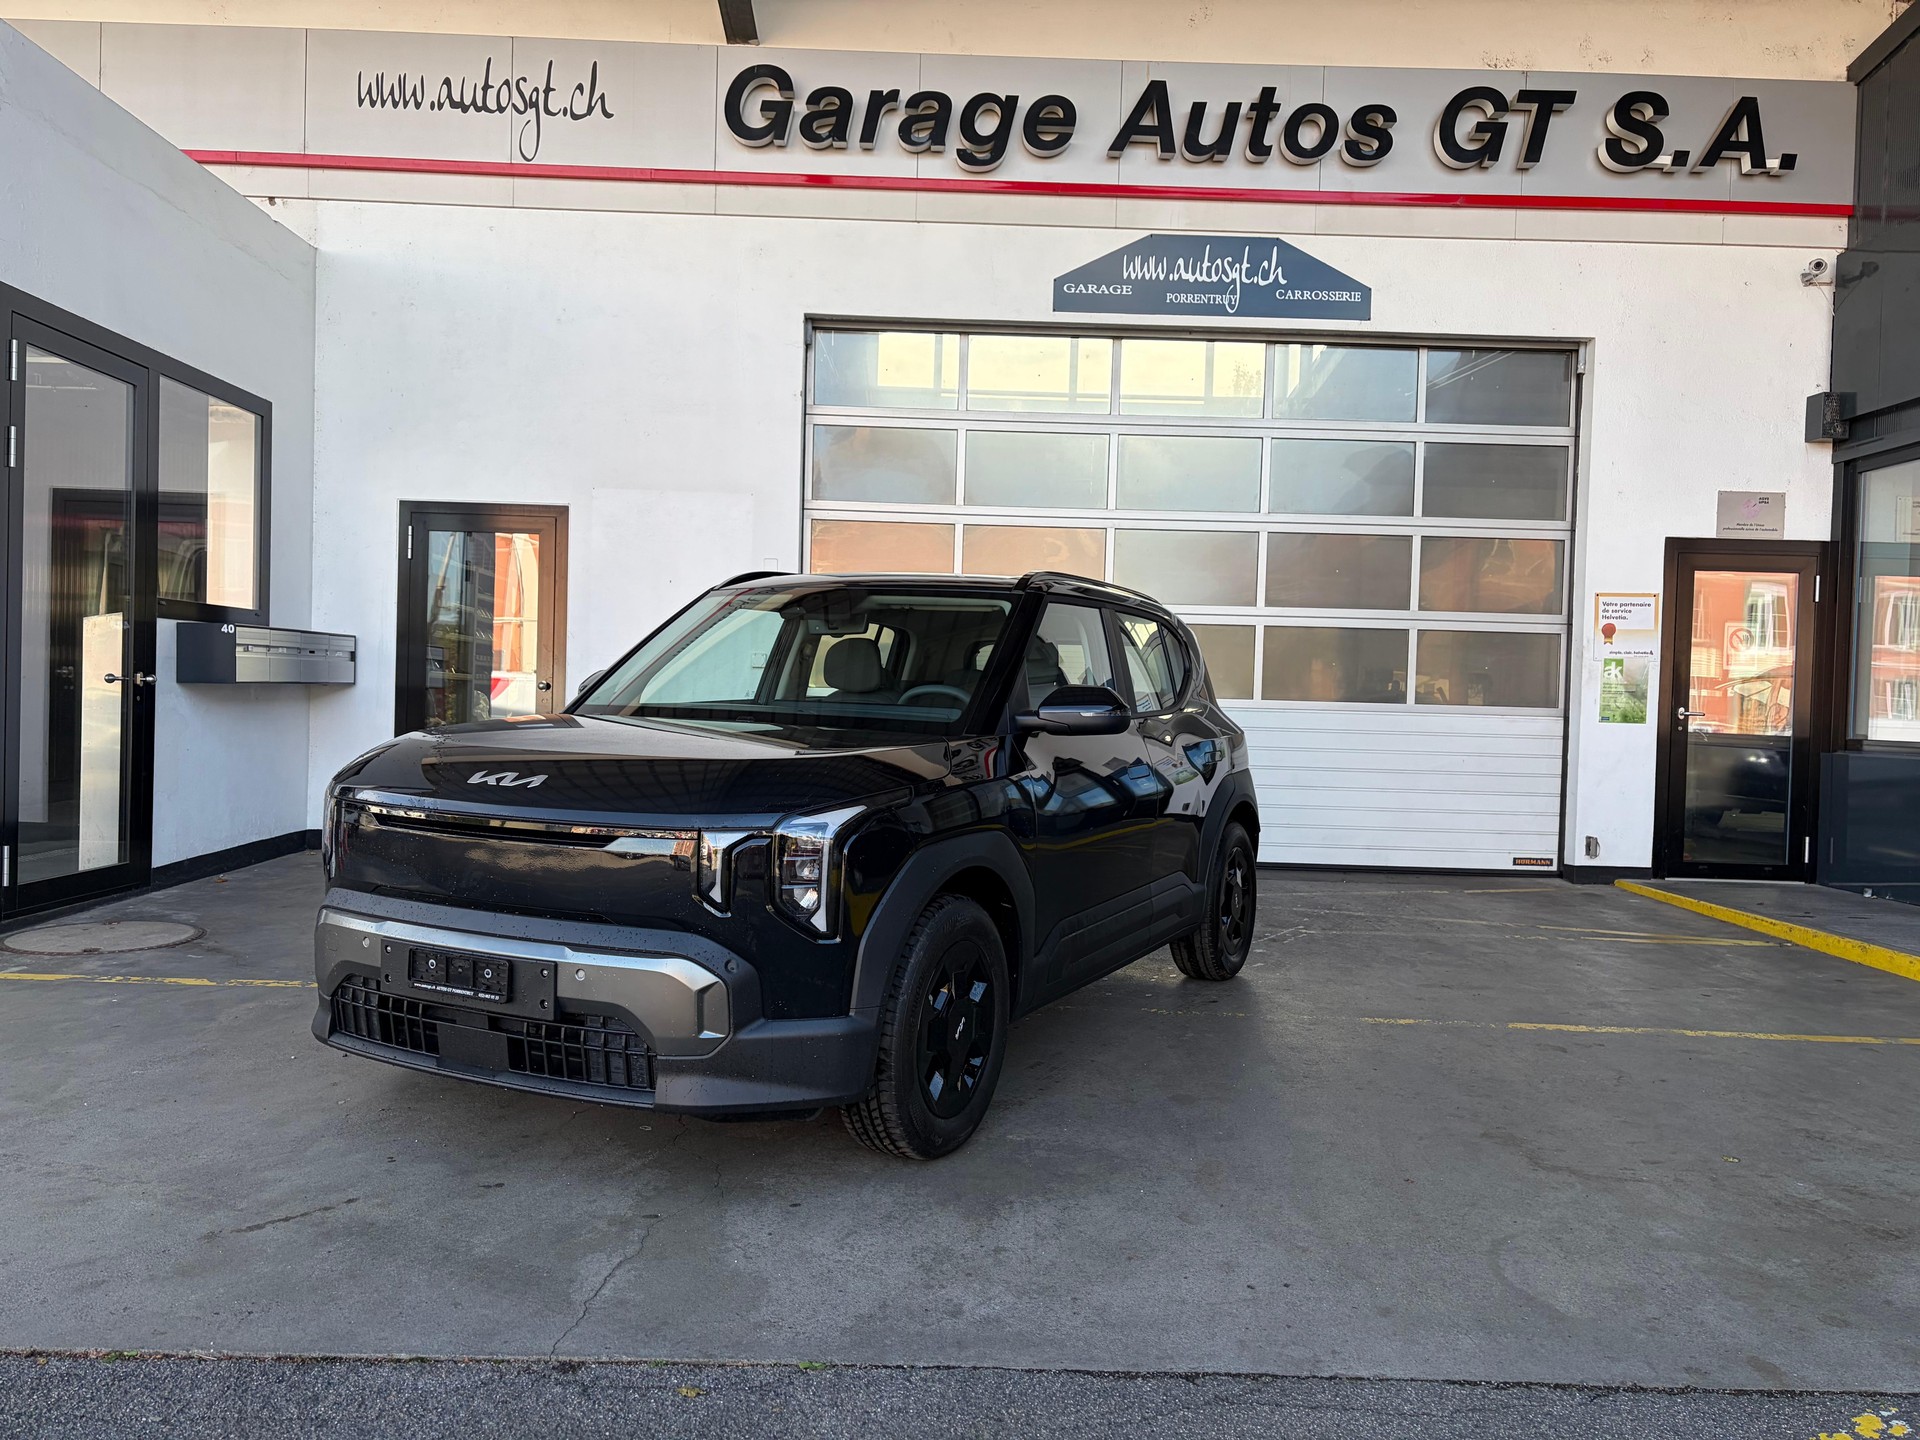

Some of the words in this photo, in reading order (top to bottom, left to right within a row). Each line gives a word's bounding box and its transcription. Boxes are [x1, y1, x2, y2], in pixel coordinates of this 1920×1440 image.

[357, 56, 615, 162] www.autosgt.ch
[724, 63, 1078, 173] Garage
[1107, 79, 1398, 168] Autos
[1432, 87, 1577, 172] GT
[1597, 90, 1799, 177] S.A.
[1122, 243, 1288, 313] www.autosgt.ch
[1063, 282, 1133, 295] GARAGE
[1166, 292, 1238, 305] PORRENTRUY
[1275, 289, 1362, 302] CARROSSERIE
[221, 624, 235, 633] 40
